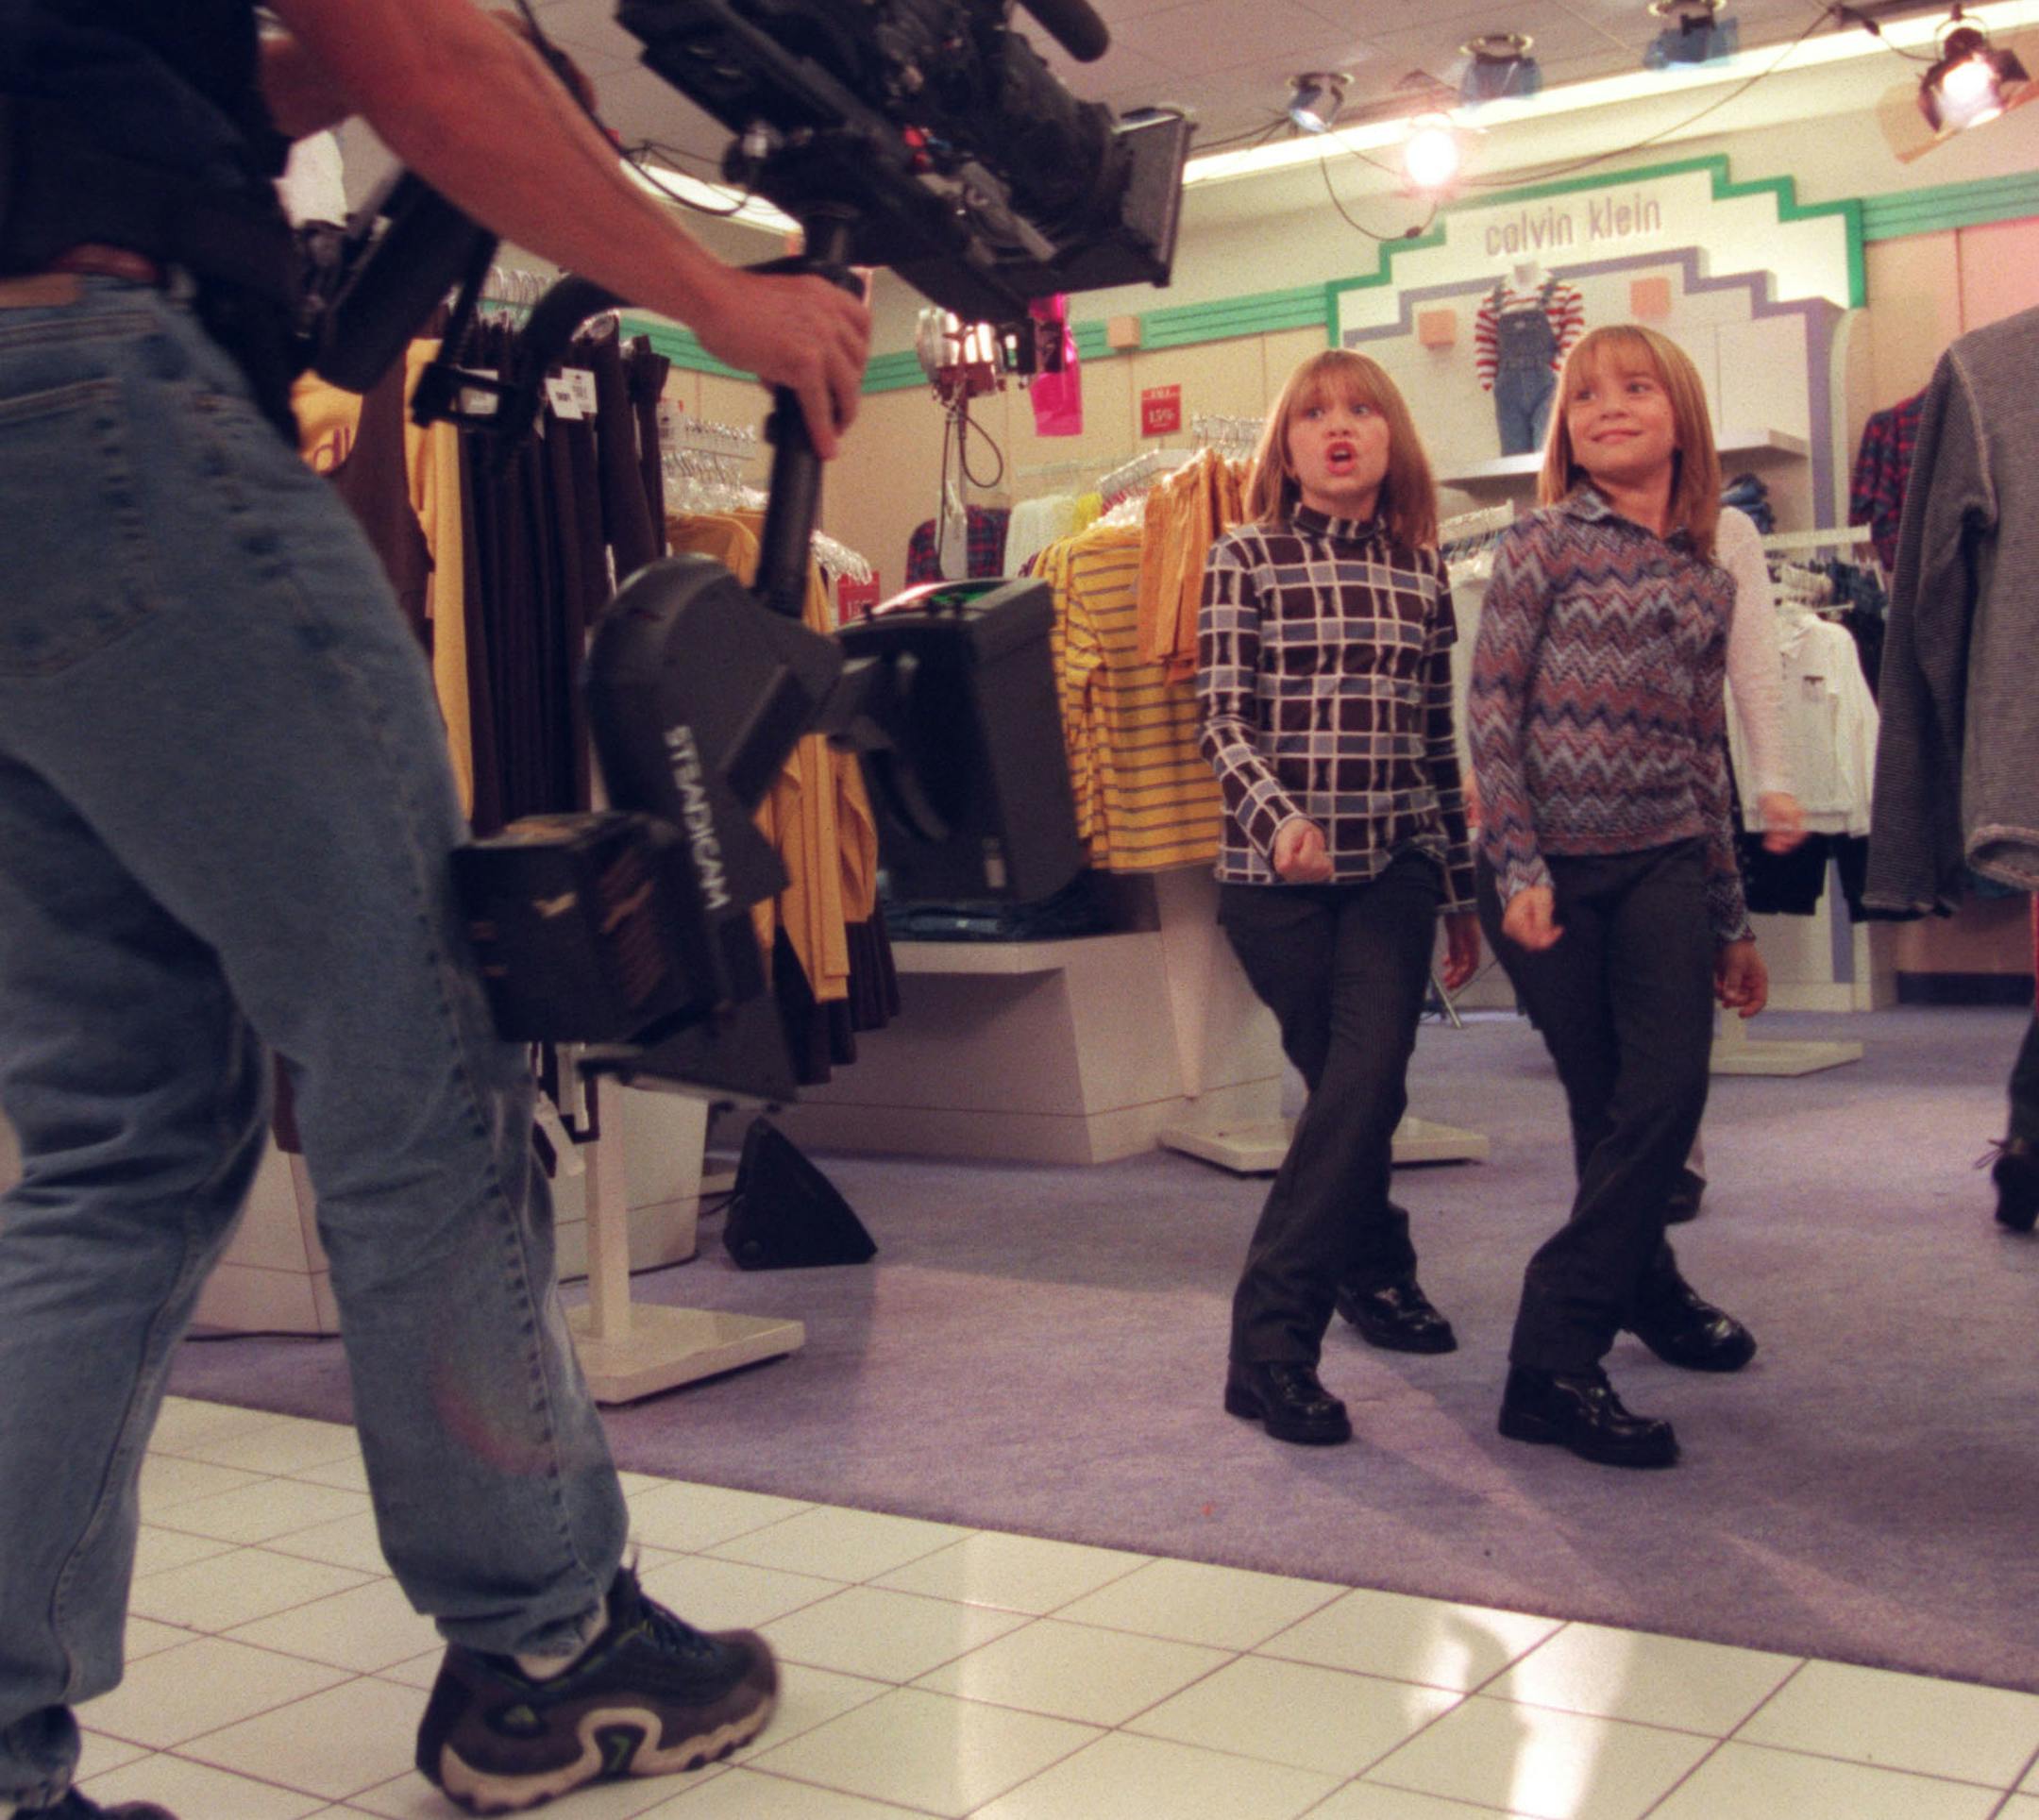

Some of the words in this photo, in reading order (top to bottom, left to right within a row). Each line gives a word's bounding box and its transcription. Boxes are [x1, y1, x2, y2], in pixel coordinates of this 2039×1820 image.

[1486, 206, 1574, 256] calvin
[1589, 193, 1661, 242] klein
[663, 725, 732, 910] STEADICAM
